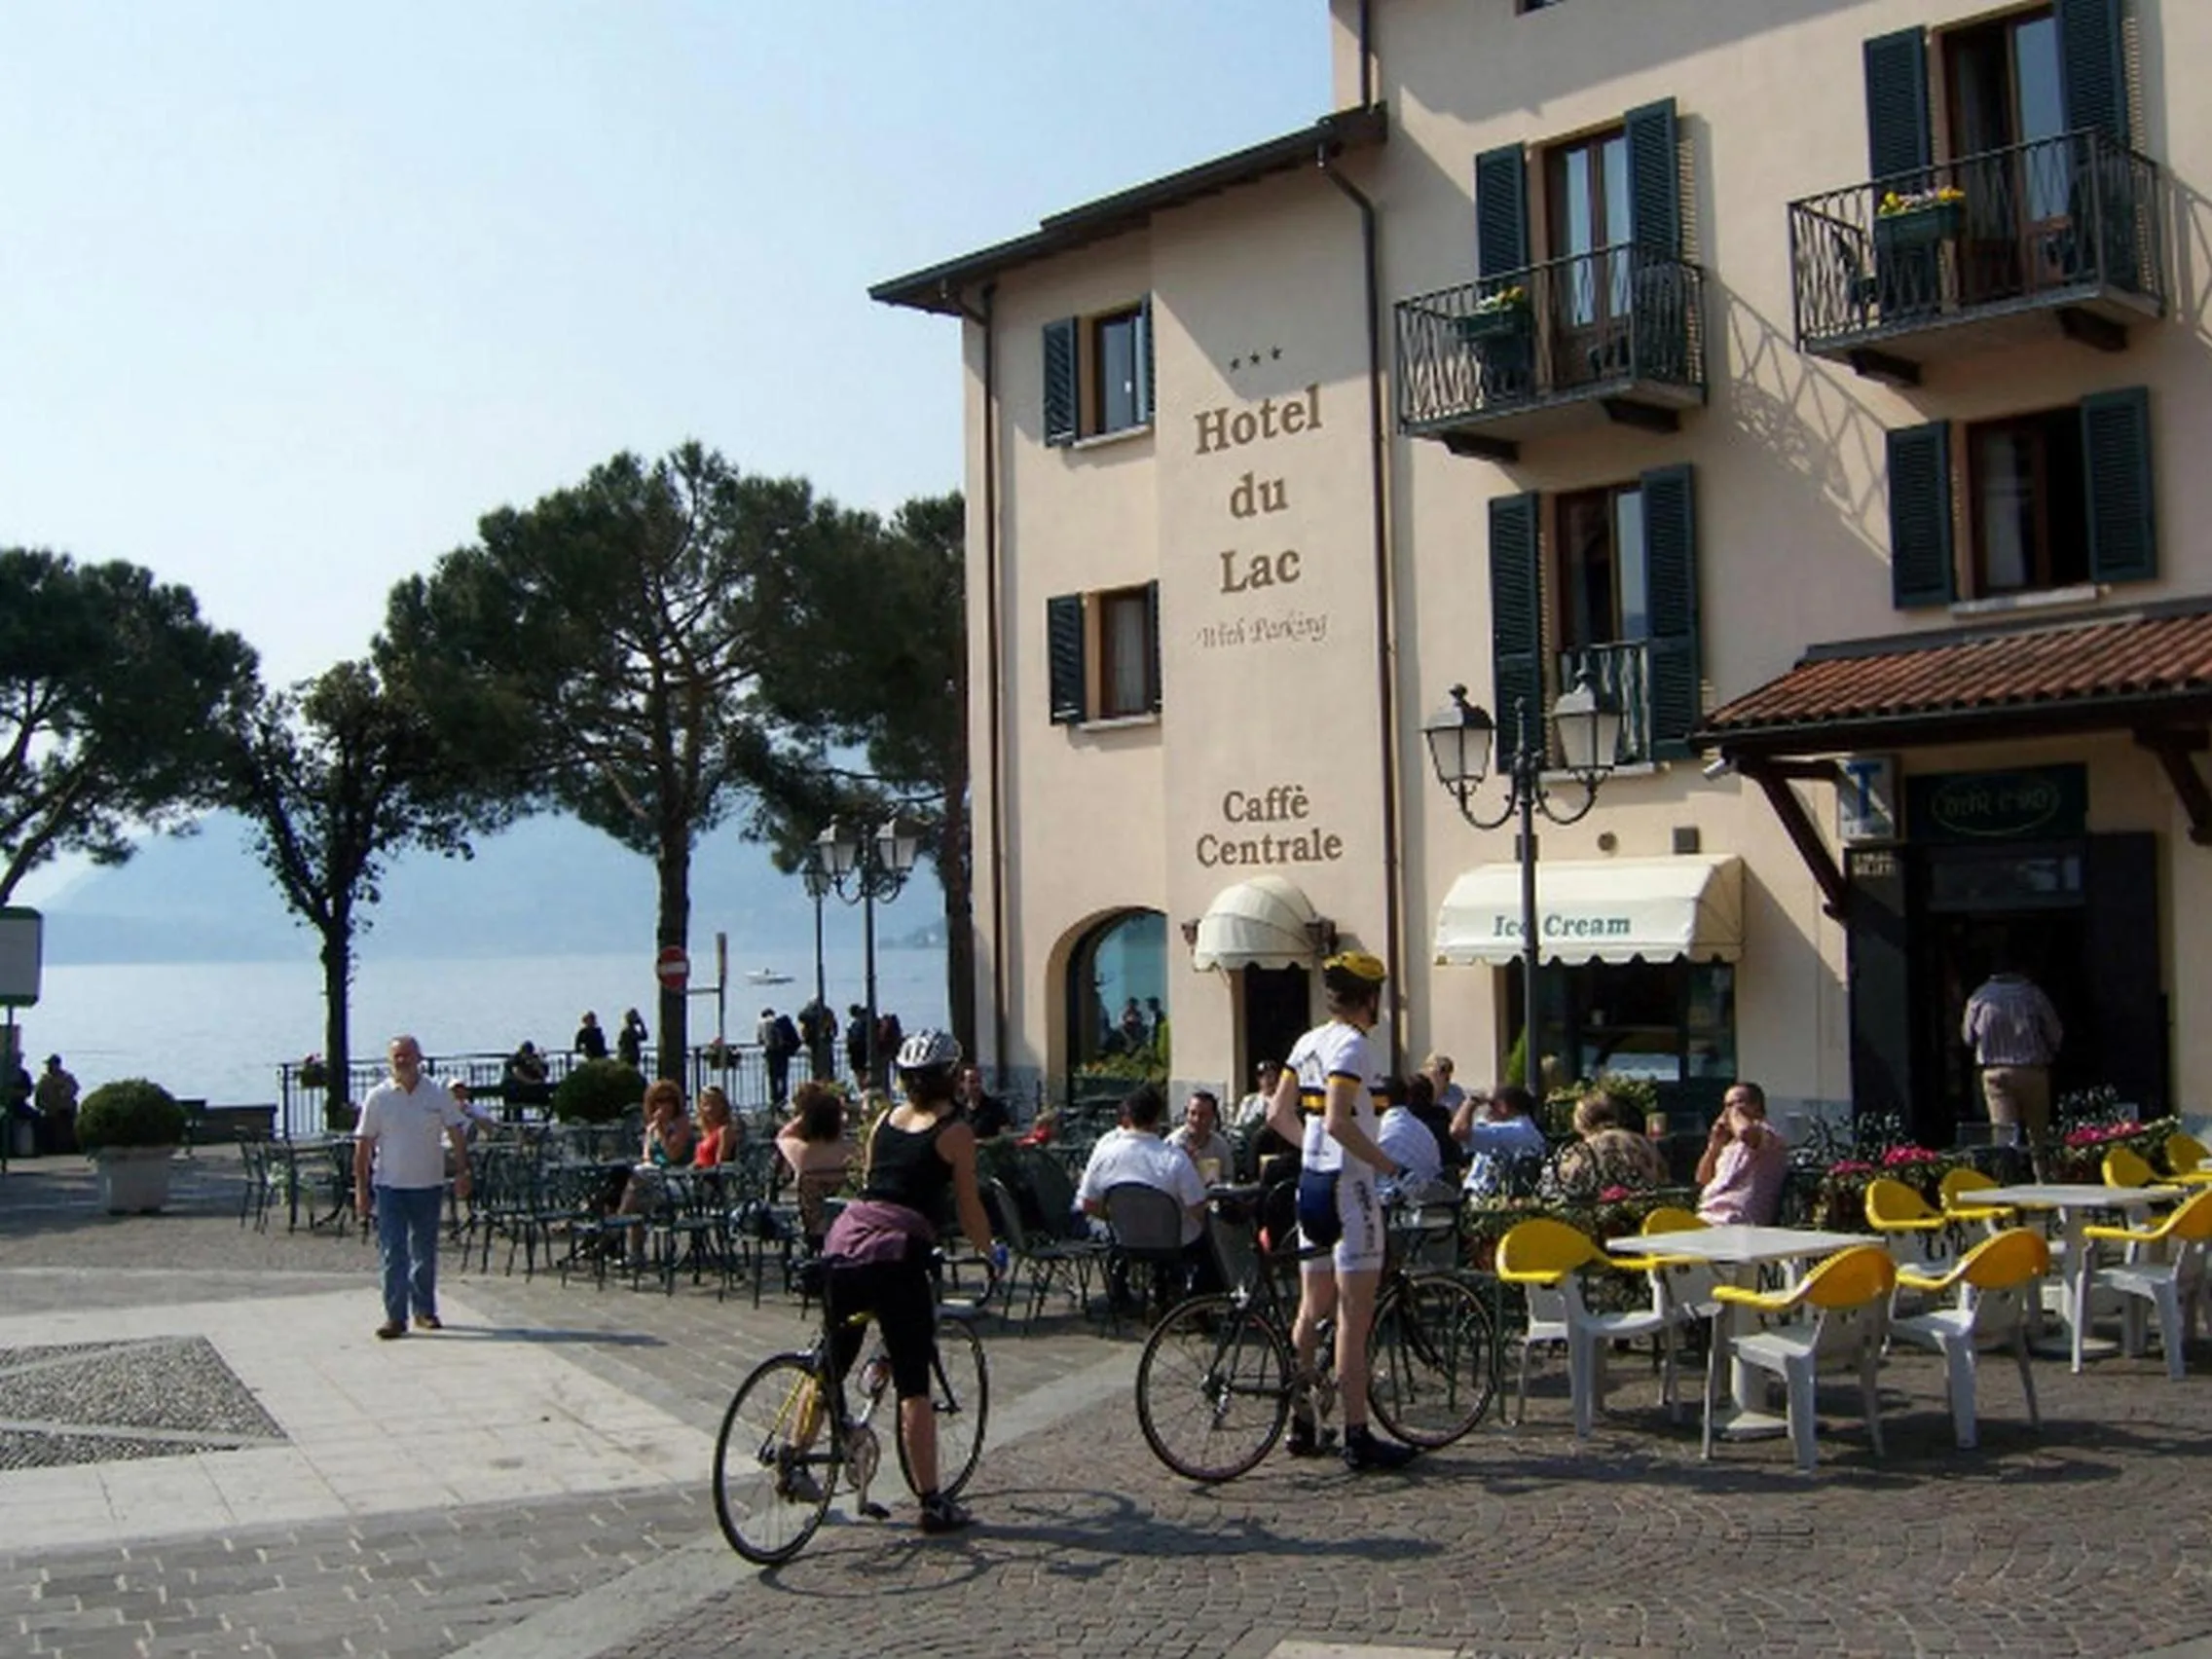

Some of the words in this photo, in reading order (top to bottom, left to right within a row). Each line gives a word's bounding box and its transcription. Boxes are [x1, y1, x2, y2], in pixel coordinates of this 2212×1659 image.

[1194, 384, 1323, 455] Hotel
[1230, 471, 1288, 519] du
[1219, 548, 1301, 594] Lac
[1250, 609, 1328, 643] Parking
[1223, 786, 1309, 824] Caffè
[1846, 762, 1881, 819] T
[1197, 828, 1343, 867] Centrale
[1543, 913, 1632, 938] Cream
